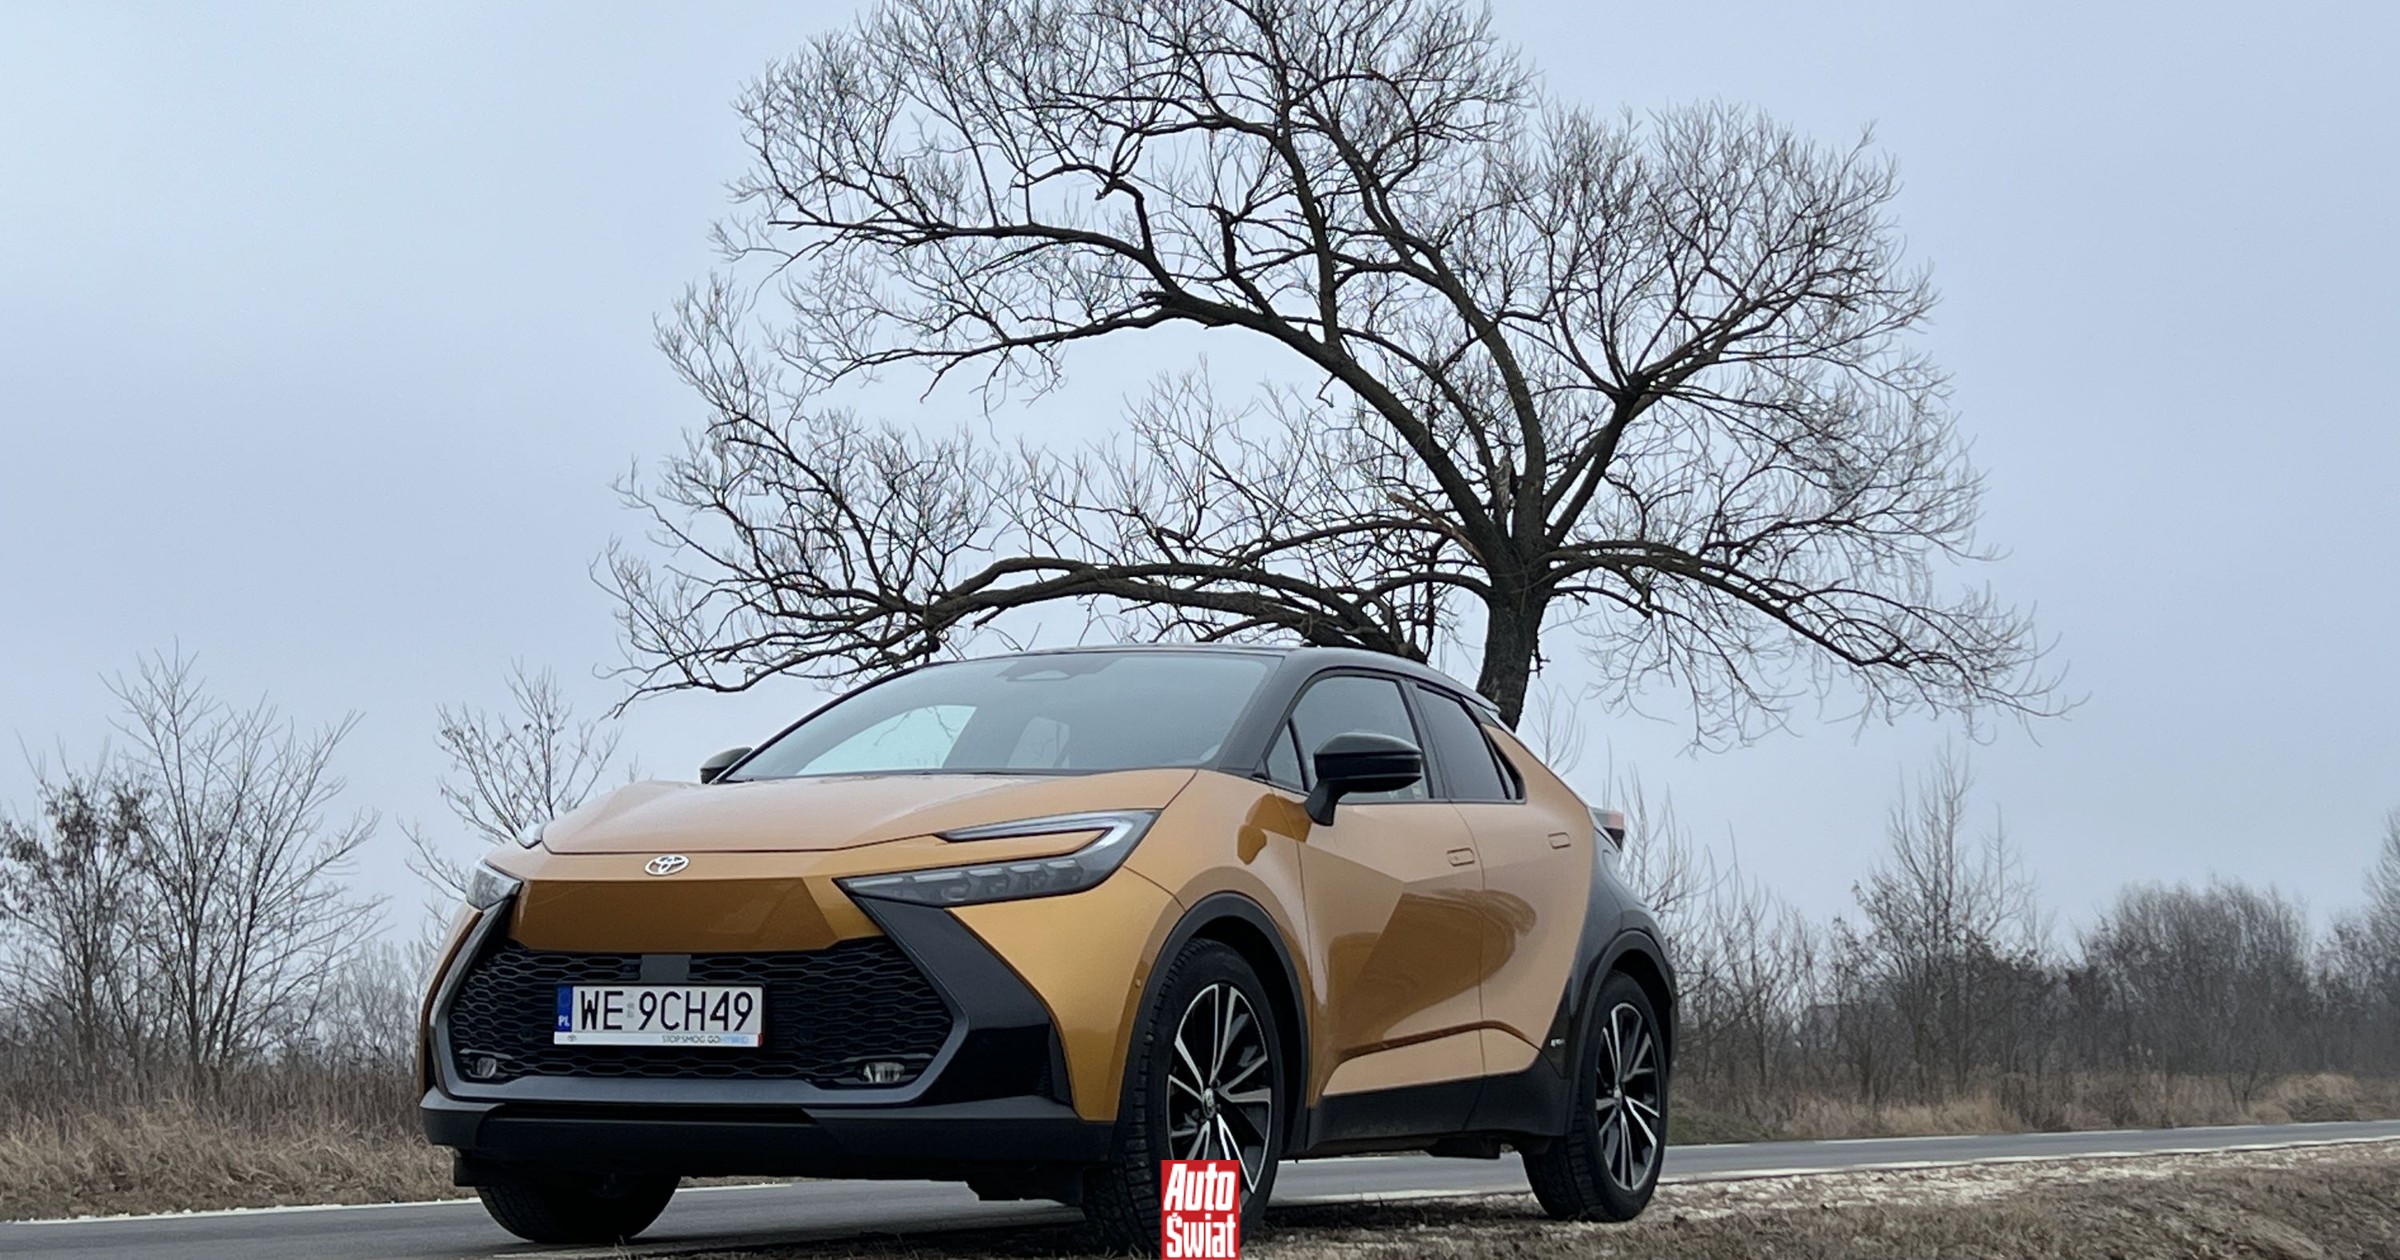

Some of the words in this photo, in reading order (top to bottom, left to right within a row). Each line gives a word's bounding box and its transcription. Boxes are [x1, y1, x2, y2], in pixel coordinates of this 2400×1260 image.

[558, 1015, 570, 1027] PL
[580, 990, 624, 1031] WE
[638, 990, 753, 1032] 9CH49
